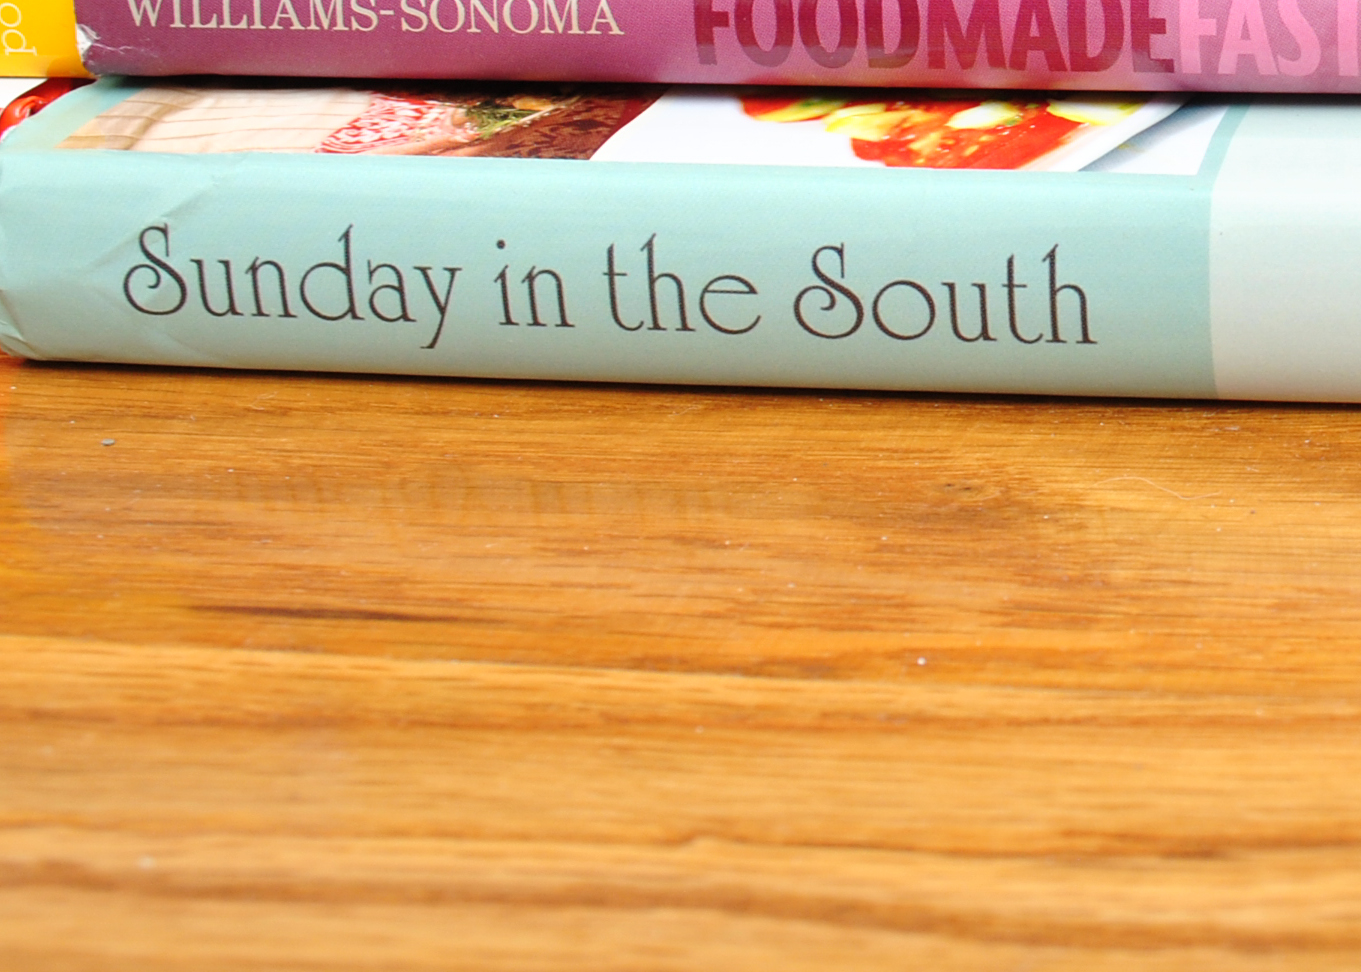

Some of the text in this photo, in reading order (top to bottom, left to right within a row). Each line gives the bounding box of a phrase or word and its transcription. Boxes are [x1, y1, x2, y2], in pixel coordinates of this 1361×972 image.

[122, 222, 462, 350] Sunday
[493, 239, 576, 330] in
[602, 232, 763, 337] the
[792, 241, 1099, 346] South
